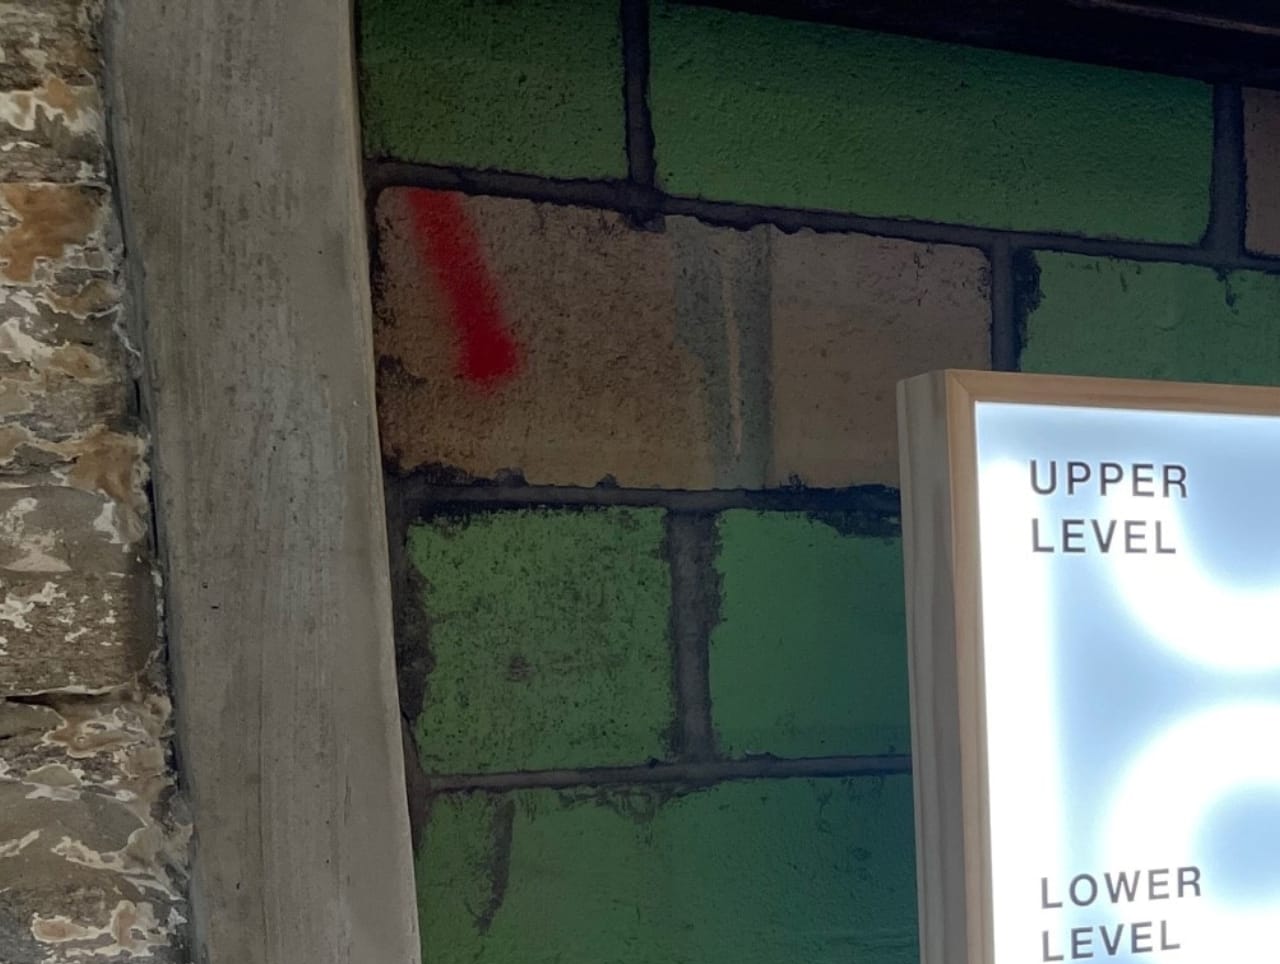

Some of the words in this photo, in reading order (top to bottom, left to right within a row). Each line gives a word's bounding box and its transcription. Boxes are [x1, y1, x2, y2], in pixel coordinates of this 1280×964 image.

[1031, 460, 1187, 498] UPPER
[1032, 518, 1176, 554] LEVEL
[1042, 866, 1200, 909] LOWER
[1042, 920, 1180, 962] LEVEL
